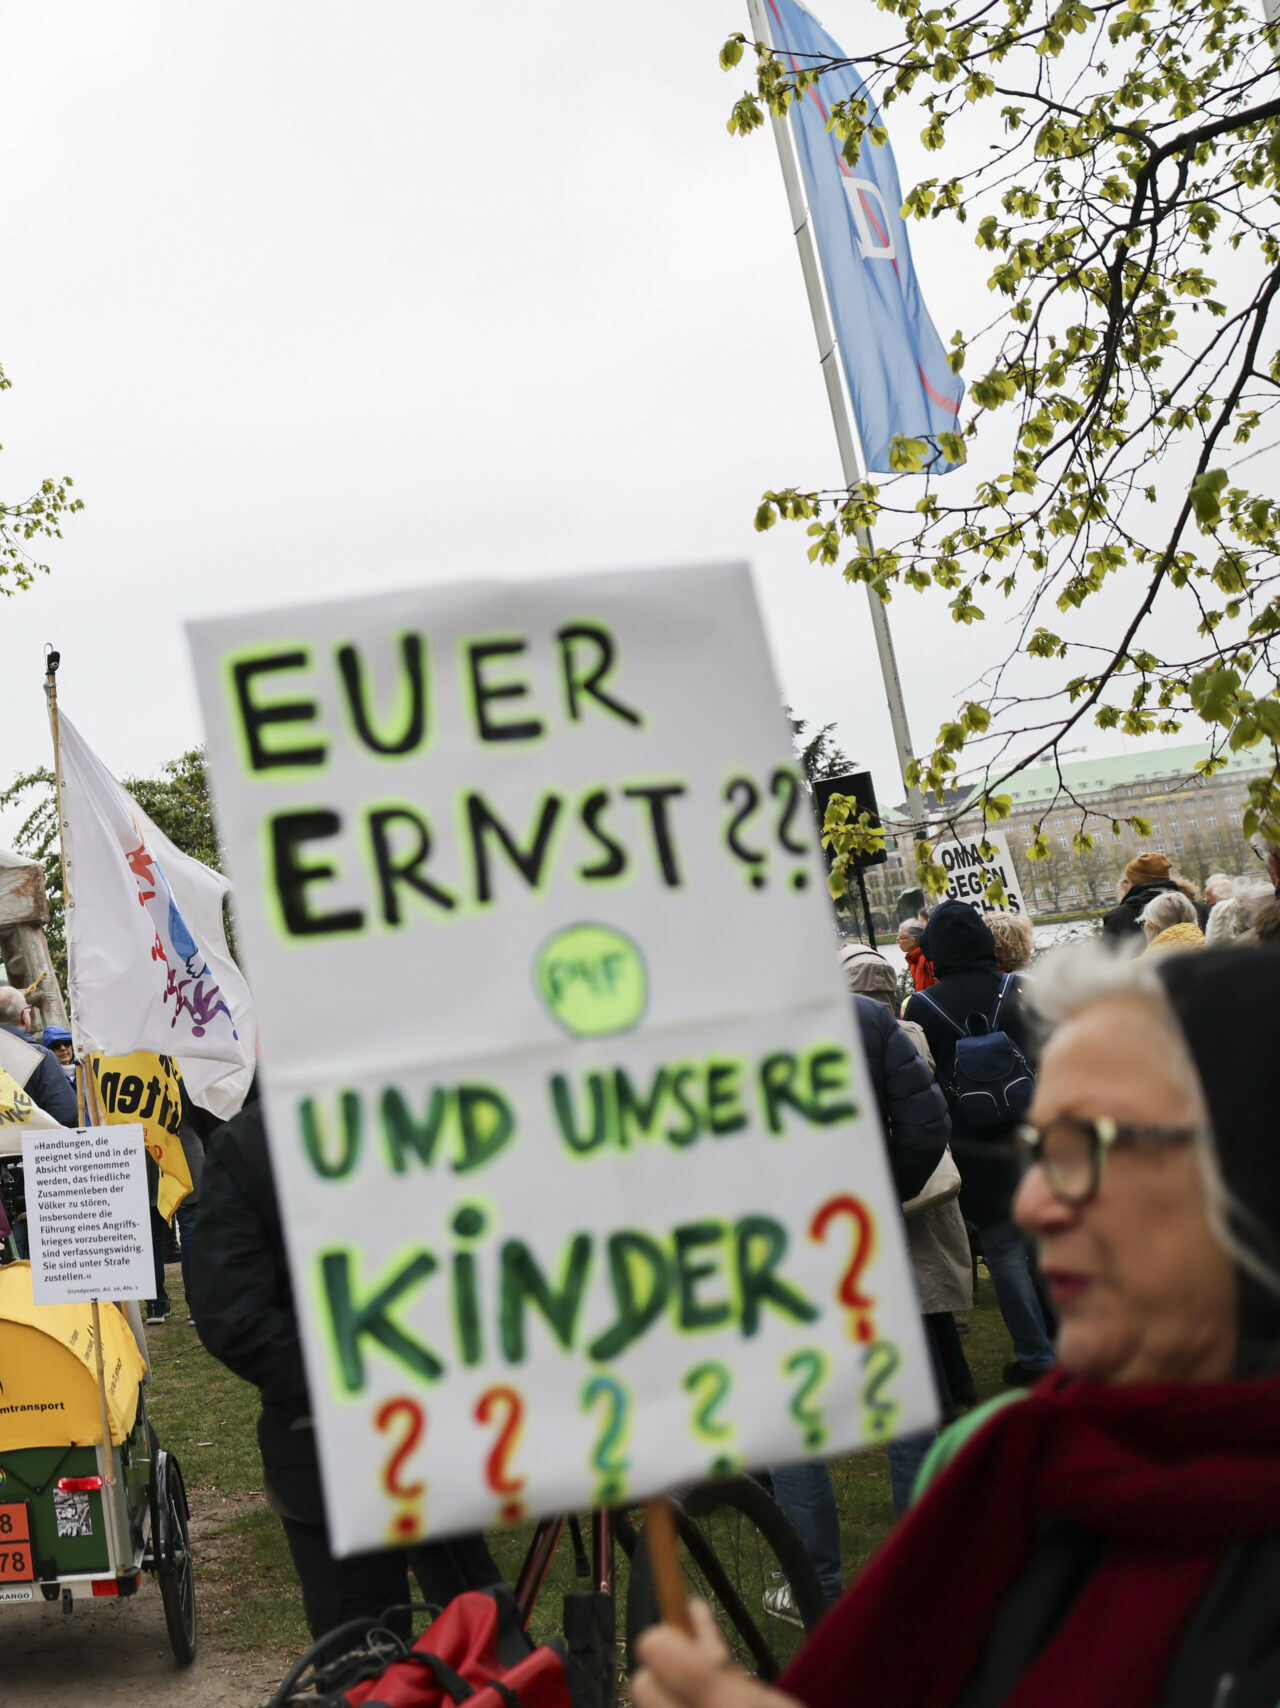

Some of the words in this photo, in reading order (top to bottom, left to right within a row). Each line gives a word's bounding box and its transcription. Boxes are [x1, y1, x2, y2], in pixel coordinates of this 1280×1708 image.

[233, 622, 642, 770] EUER
[271, 784, 687, 935] ERNST
[299, 1085, 513, 1180] UND
[549, 1048, 858, 1156] UNSERE
[96, 1138, 109, 1146] die
[35, 1152, 72, 1164] geeignet
[74, 1151, 92, 1159] sind
[95, 1150, 110, 1158] und
[113, 1149, 121, 1157] in
[123, 1148, 137, 1156] der
[36, 1165, 67, 1174] Absicht
[70, 1162, 130, 1172] vorgenommen
[37, 1176, 71, 1186] werden,
[73, 1175, 88, 1183] das
[90, 1173, 130, 1182] friedliche
[38, 1187, 107, 1198] Zusammenleben
[110, 1185, 124, 1193] der
[39, 1200, 66, 1210] Völker
[81, 1199, 110, 1208] stören,
[40, 1212, 96, 1222] insbesondere
[99, 1210, 112, 1218] die
[41, 1224, 75, 1234] Führung
[78, 1223, 100, 1231] eines
[103, 1220, 139, 1231] Angriffs-
[41, 1236, 73, 1246] krieges
[75, 1233, 136, 1244] vorzubereiten,
[42, 1249, 60, 1258] sind
[62, 1244, 144, 1257] verfassungswidrig.
[43, 1261, 56, 1270] Sie
[59, 1260, 77, 1269] sind
[79, 1259, 101, 1267] unter
[104, 1257, 130, 1266] Strafe
